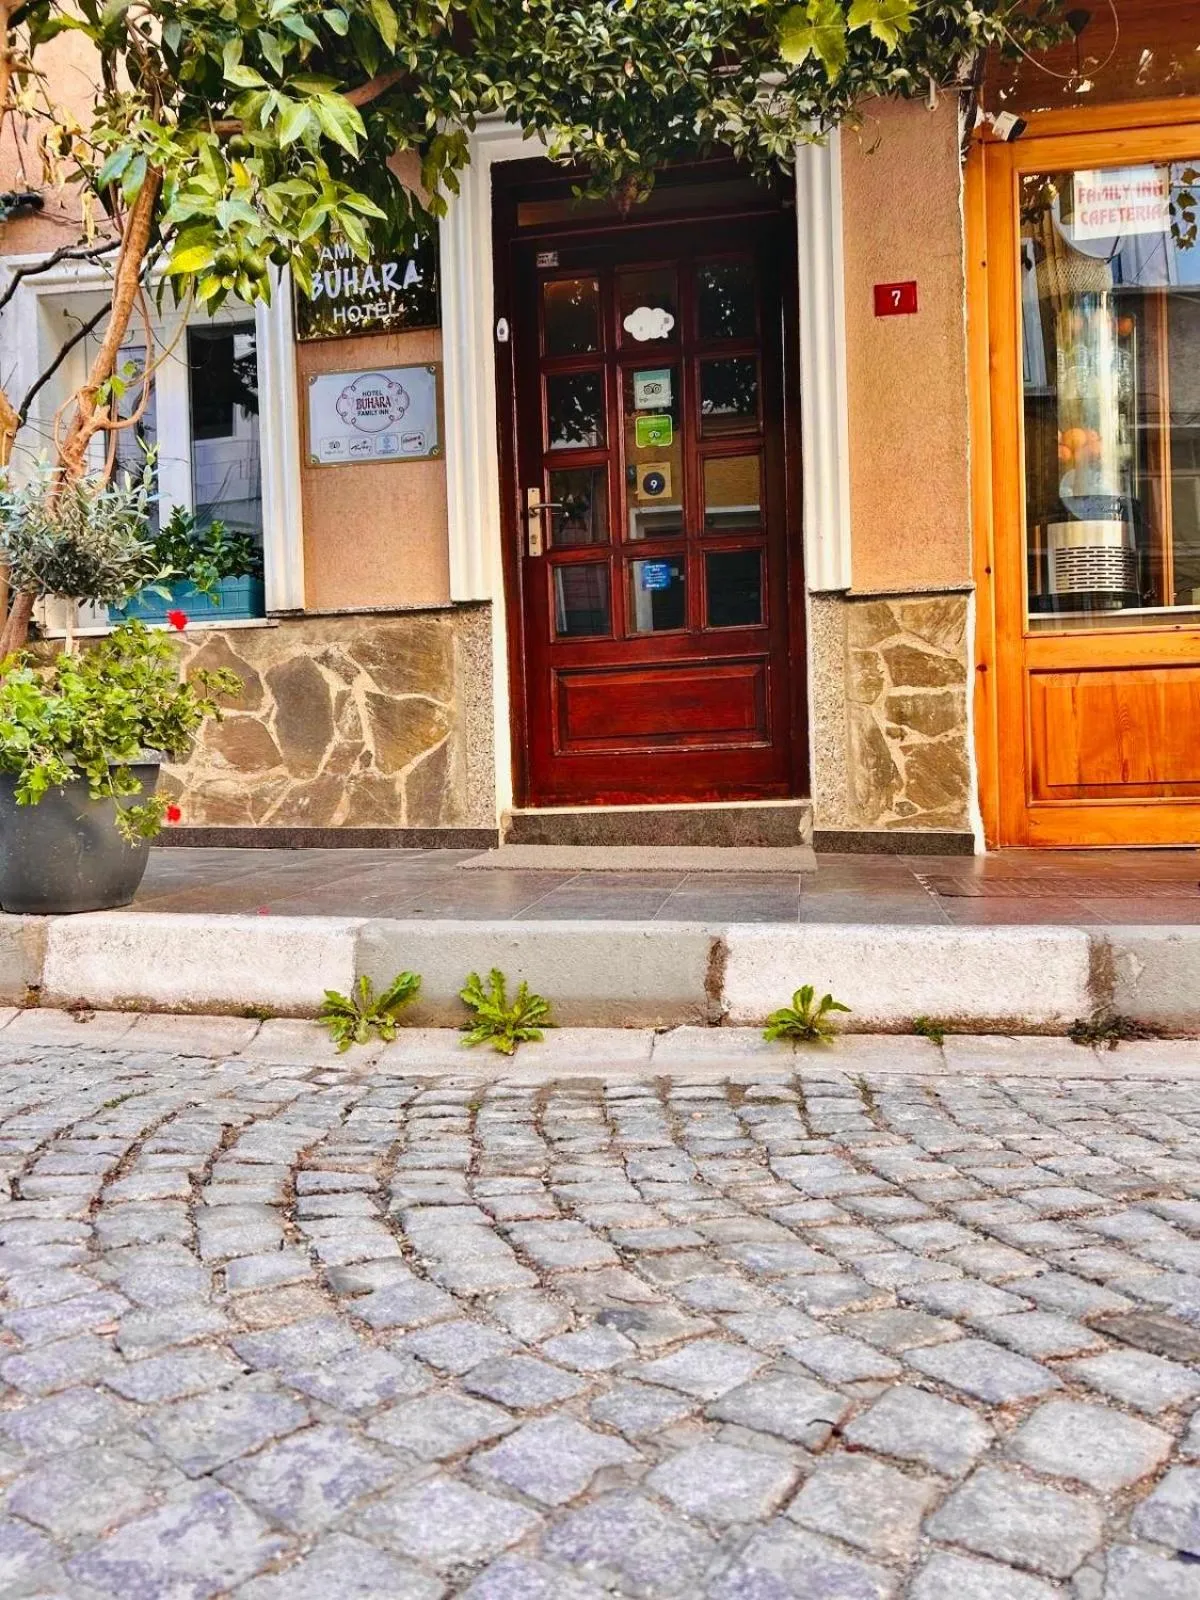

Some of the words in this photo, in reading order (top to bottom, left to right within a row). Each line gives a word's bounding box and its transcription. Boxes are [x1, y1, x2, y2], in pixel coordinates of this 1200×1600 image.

[1137, 180, 1164, 198] INN
[1080, 204, 1162, 226] CAFETERIA
[311, 259, 423, 302] BUHARA
[891, 290, 901, 307] 7
[333, 302, 400, 325] HOTEL
[356, 395, 392, 411] BUHARA
[650, 480, 658, 489] 9
